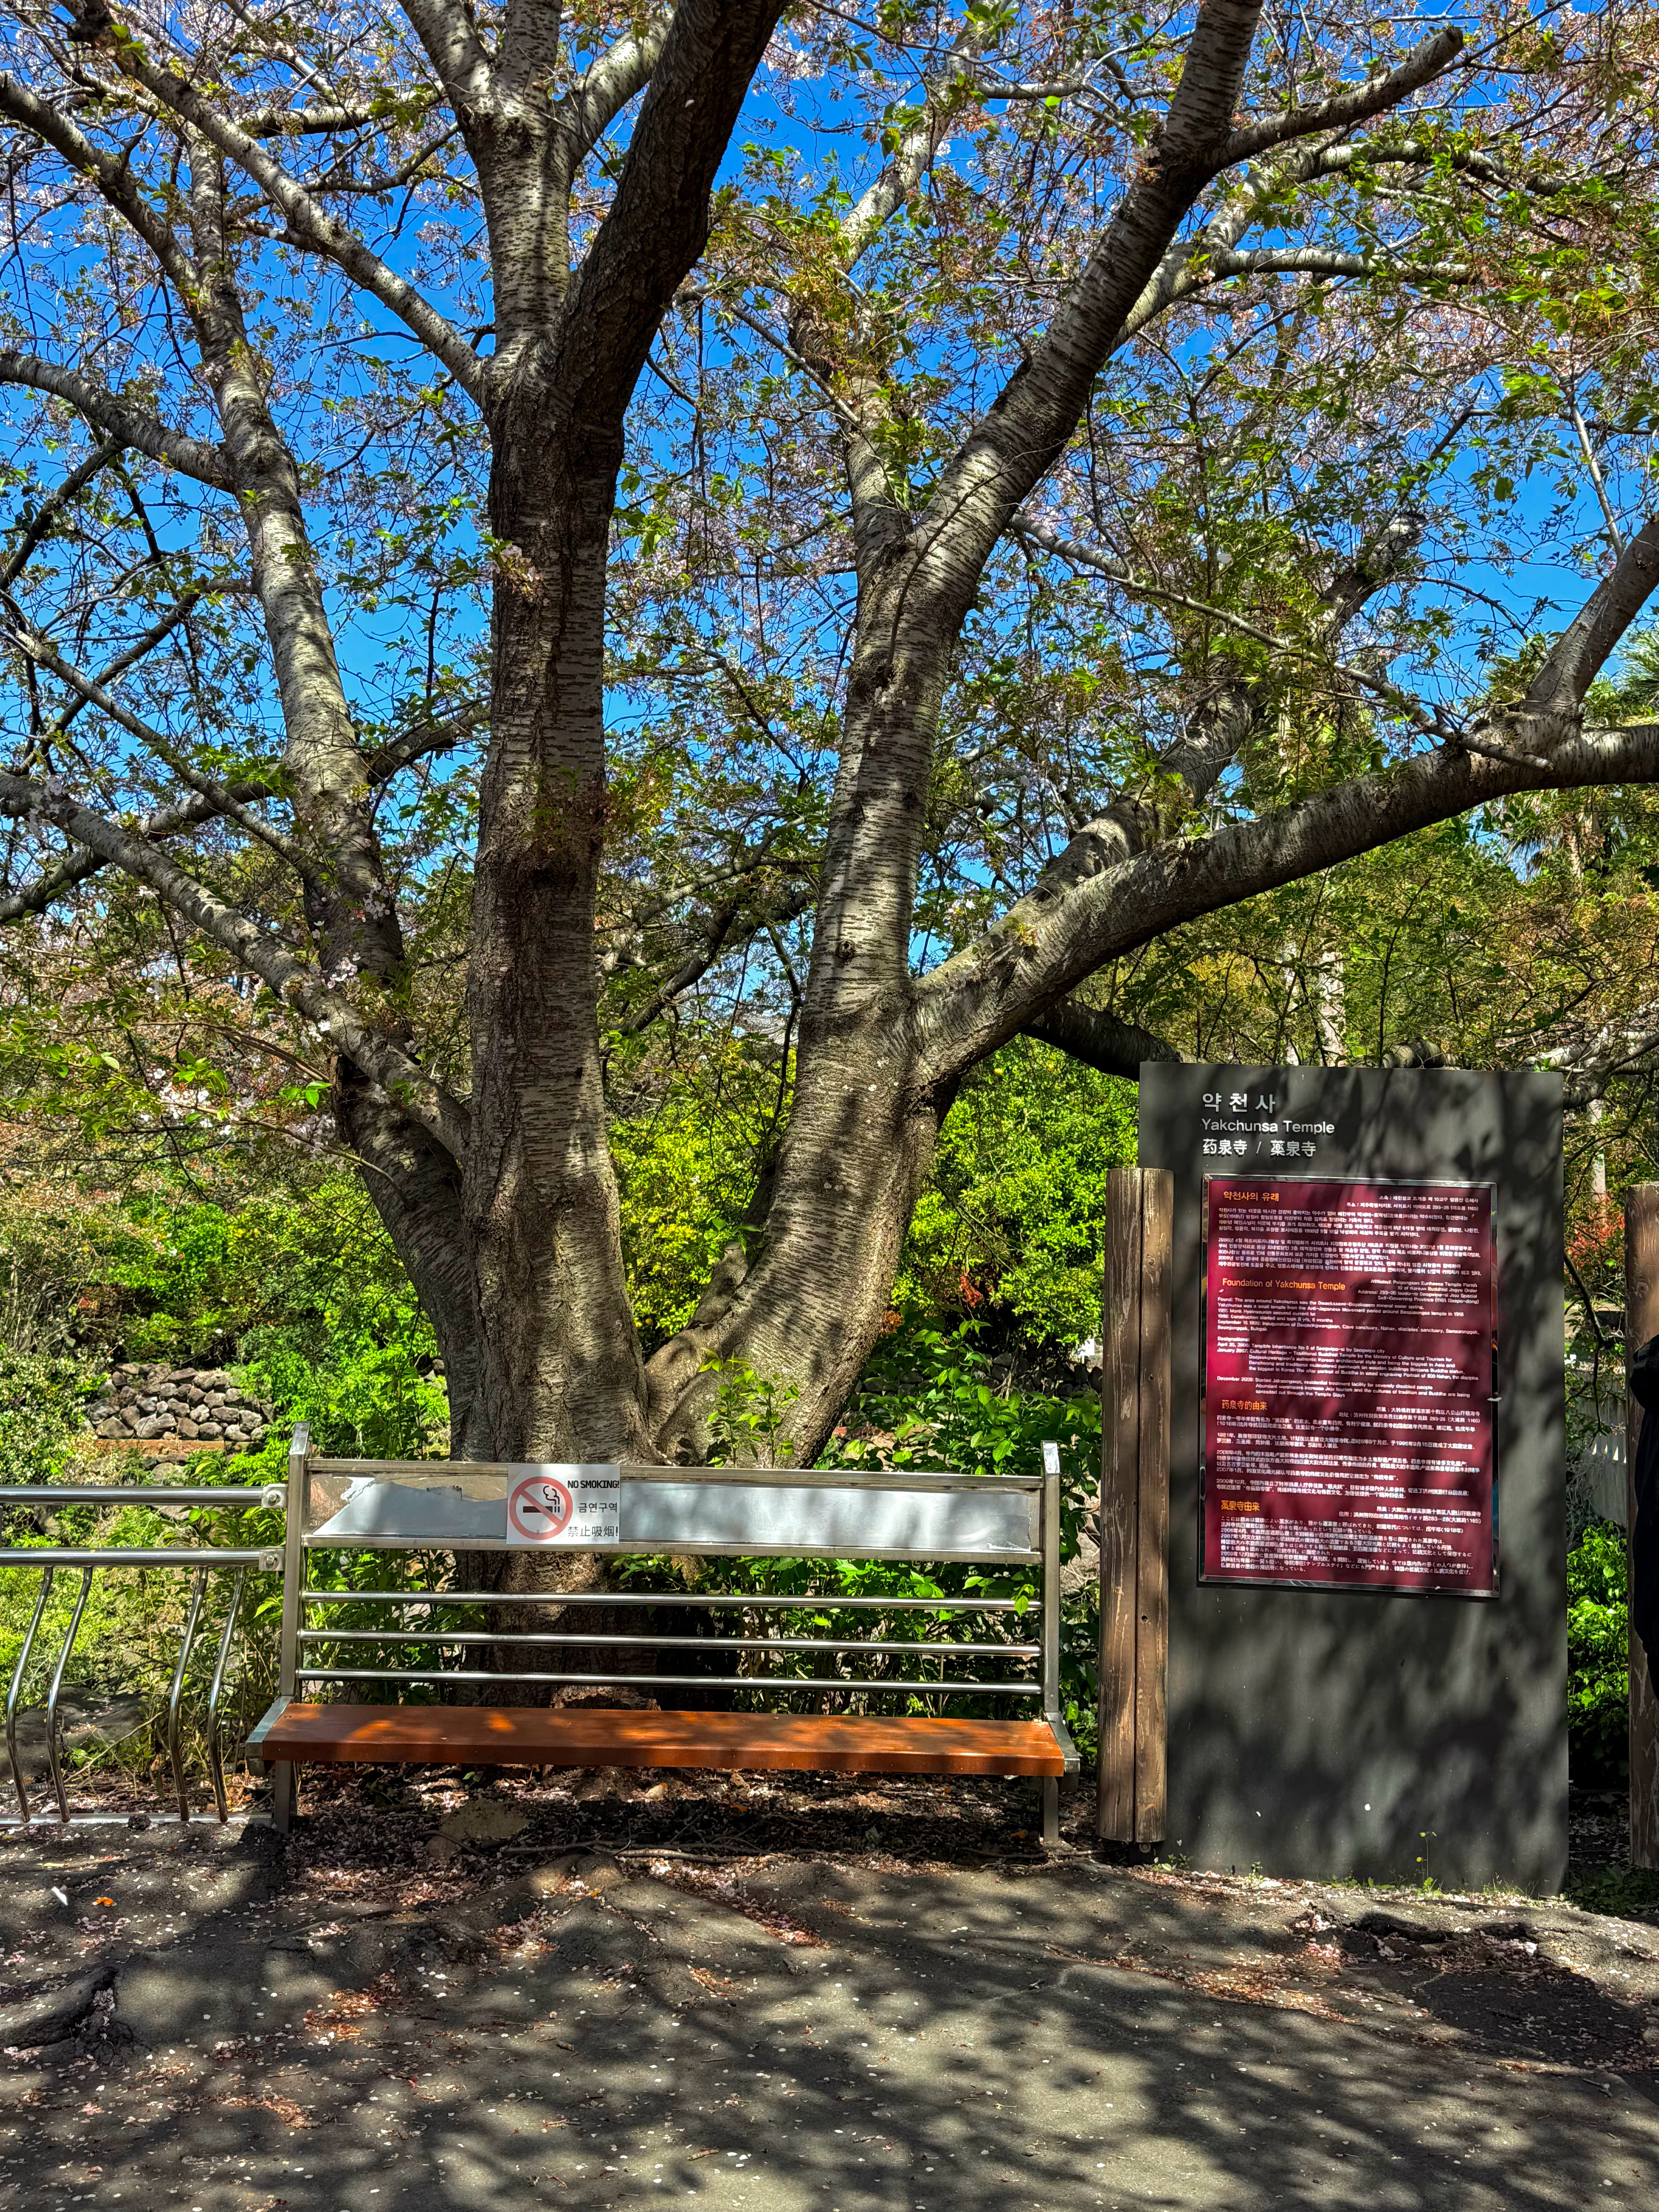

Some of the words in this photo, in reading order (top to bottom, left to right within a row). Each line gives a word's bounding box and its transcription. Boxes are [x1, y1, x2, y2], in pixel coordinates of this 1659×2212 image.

[1202, 1118, 1278, 1132] Yakchunsa
[1283, 1120, 1335, 1135] Temple
[1202, 1139, 1247, 1155] 药泉寺
[1223, 1190, 1258, 1201] 약천사의
[1262, 1192, 1279, 1202] 유래
[1223, 1278, 1263, 1287] Foundation
[1275, 1280, 1315, 1289] Yakchunsa
[1318, 1281, 1345, 1291] Temple
[1221, 1400, 1267, 1410] 药泉寺的由来
[580, 1480, 619, 1489] SMOKING!
[578, 1503, 617, 1513] 금연구역
[568, 1526, 618, 1537] 禁止吸烟!
